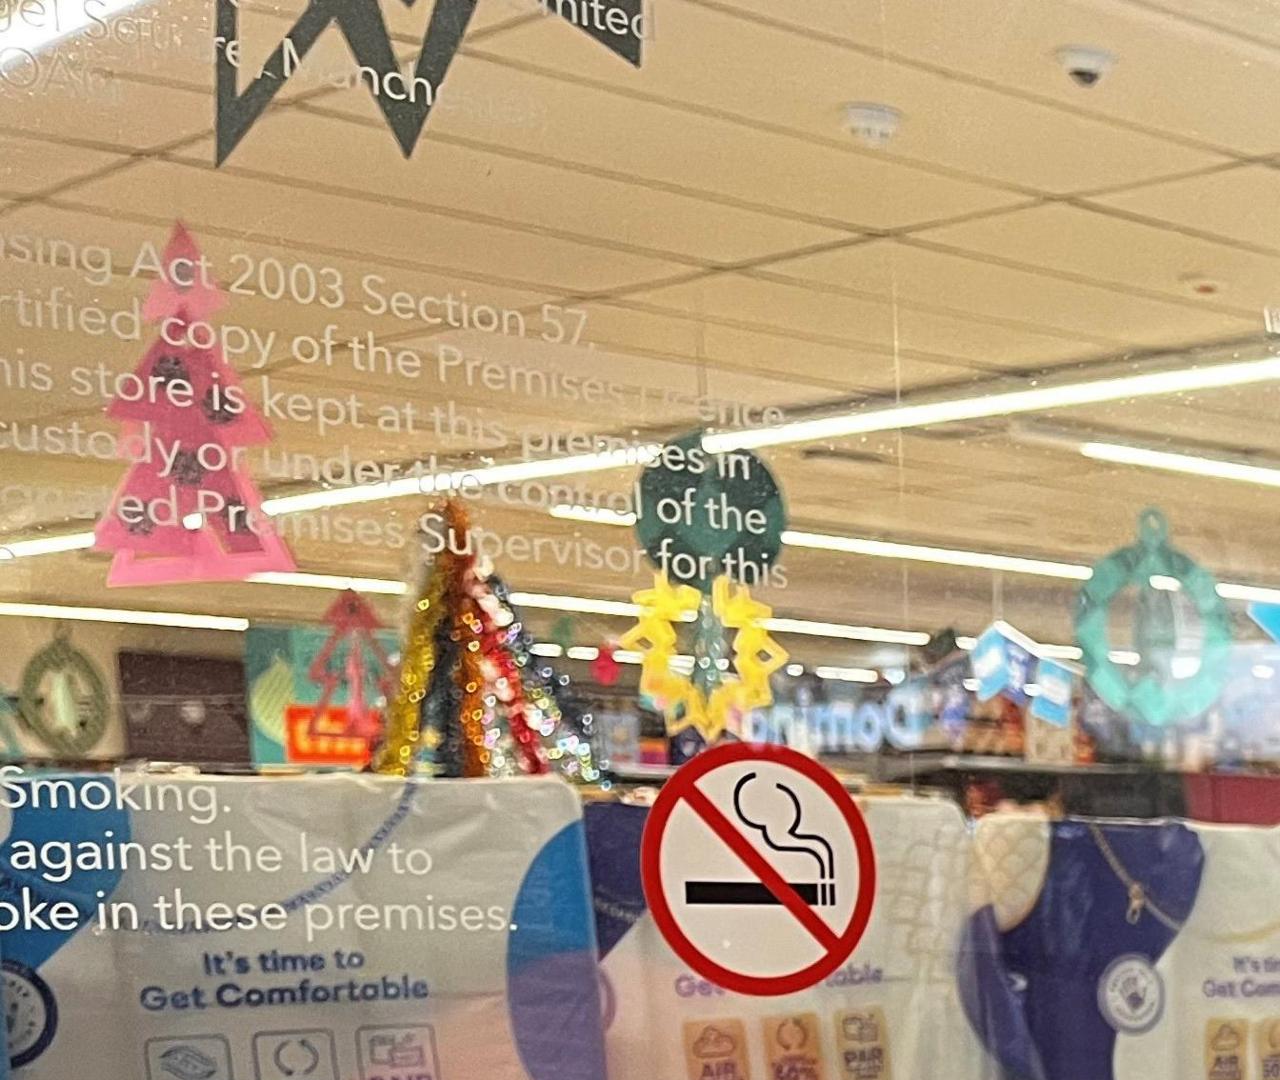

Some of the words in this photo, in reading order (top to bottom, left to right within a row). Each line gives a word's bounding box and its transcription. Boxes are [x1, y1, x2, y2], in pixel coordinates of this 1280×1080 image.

[130, 241, 215, 290] Act
[228, 253, 345, 310] 2003
[362, 273, 525, 337] Section
[160, 315, 276, 369] copy
[291, 325, 338, 366] of
[348, 331, 422, 378] the
[437, 344, 630, 406] Premises
[71, 363, 194, 409] store
[210, 371, 247, 415] is
[262, 375, 366, 436] kept
[377, 397, 416, 437] at
[430, 400, 509, 451] this
[716, 440, 752, 481] in
[198, 442, 247, 472] or
[264, 441, 403, 487] under
[656, 490, 696, 527] of
[704, 492, 768, 535] the
[419, 512, 647, 575] Supervisor
[656, 537, 714, 582] for
[722, 548, 790, 590] this
[0, 765, 231, 828] Smoking.
[10, 828, 193, 882] against
[207, 830, 283, 876] the
[301, 829, 375, 876] law
[388, 839, 433, 877] to
[97, 889, 139, 931] in
[155, 890, 288, 932] these
[305, 892, 519, 941] premises.
[139, 982, 202, 1013] Get
[214, 972, 430, 1009] Comfortable
[203, 951, 251, 978] It's
[259, 948, 325, 975] time
[335, 947, 365, 972] to
